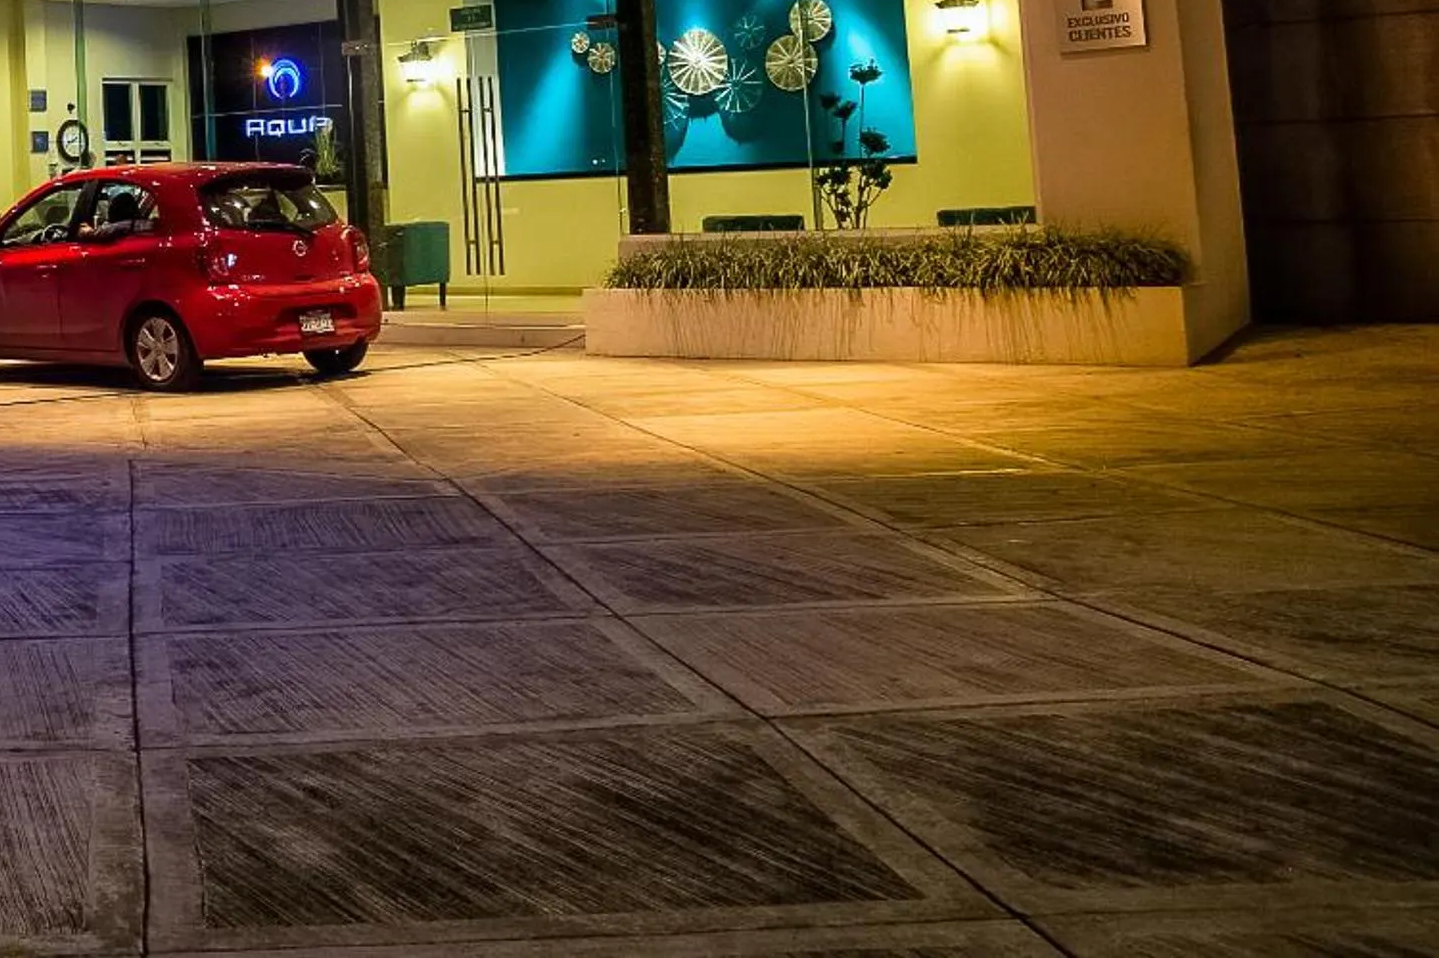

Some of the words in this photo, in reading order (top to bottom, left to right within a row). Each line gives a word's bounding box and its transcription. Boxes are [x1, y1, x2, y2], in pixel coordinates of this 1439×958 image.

[1067, 12, 1130, 28] EXCLUSIVO
[1068, 25, 1132, 42] CLIENTES
[245, 115, 334, 139] AQUA
